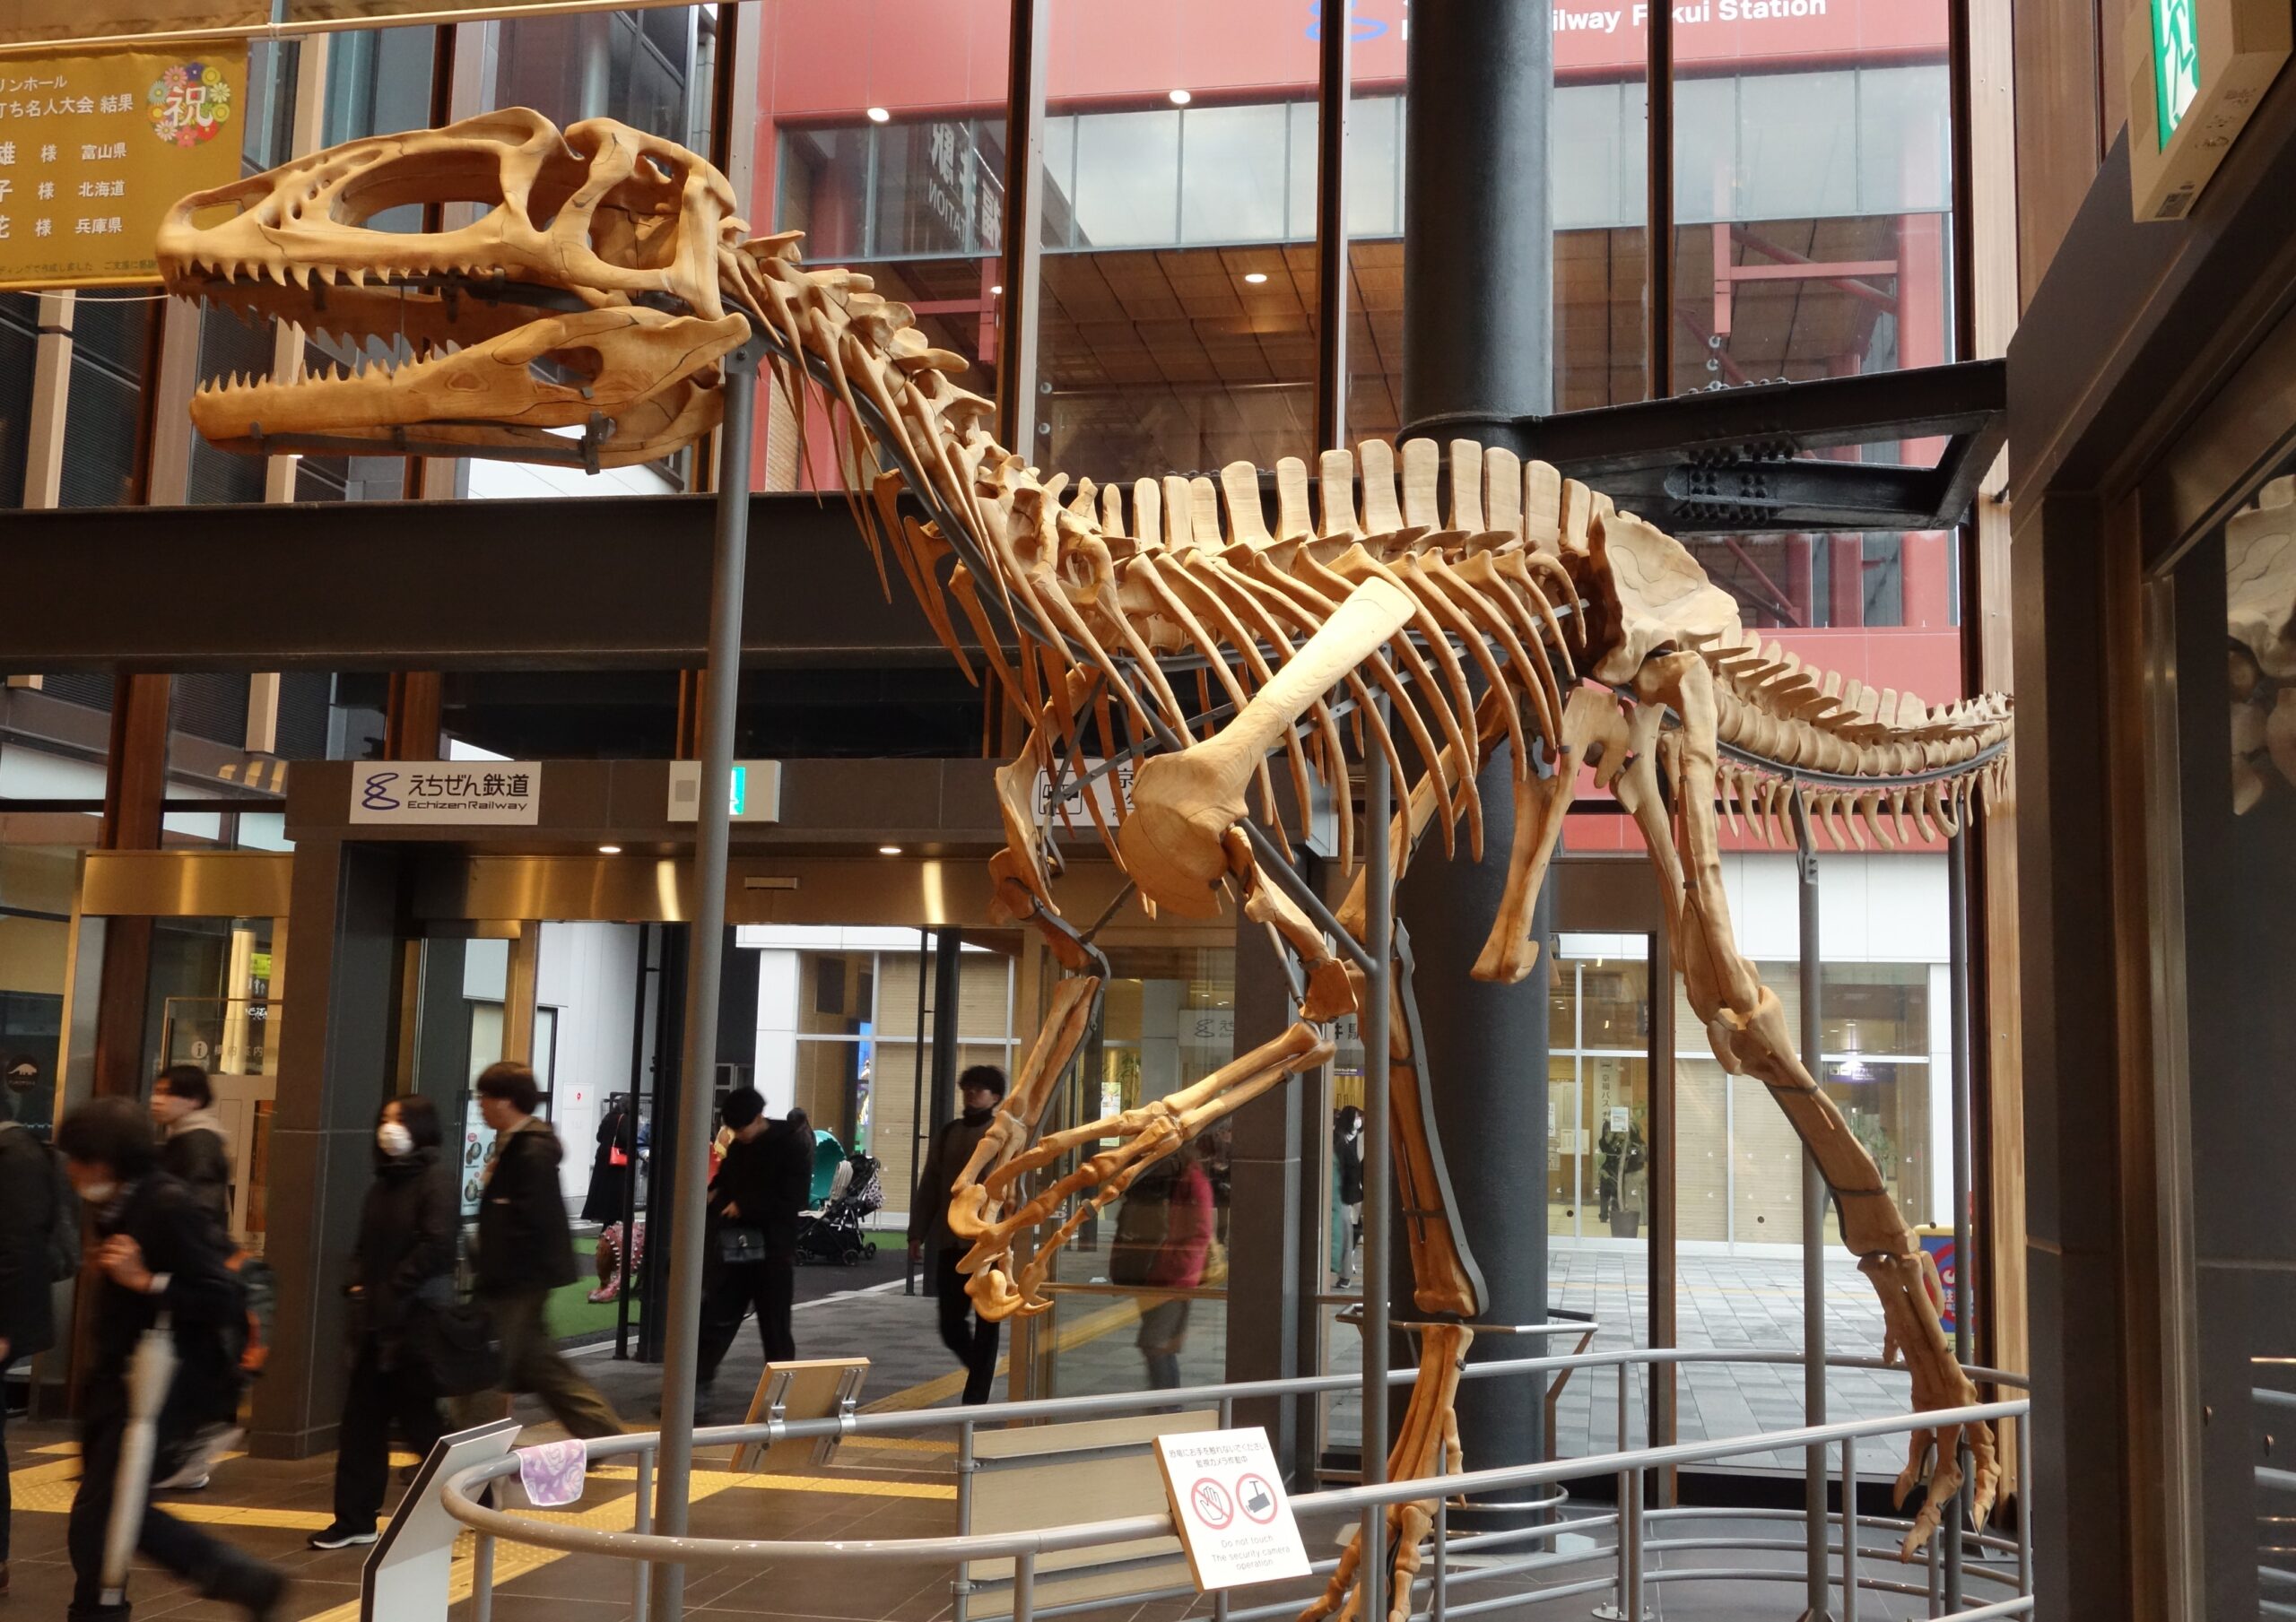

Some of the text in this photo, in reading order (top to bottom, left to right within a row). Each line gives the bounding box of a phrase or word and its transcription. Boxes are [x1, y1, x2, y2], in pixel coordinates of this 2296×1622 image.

[1552, 0, 1826, 33] ilway Fkui Station
[100, 93, 134, 114] 結果
[164, 86, 213, 127] 祝
[40, 144, 57, 163] 様
[81, 142, 127, 160] 富山県
[38, 181, 55, 200] 様
[78, 179, 126, 197] 北海道
[36, 218, 52, 237] 様
[75, 217, 123, 234] 兵庫県
[408, 773, 529, 796] えちぜん鉄道
[407, 801, 528, 811] Echizen Railway
[1221, 1534, 1274, 1548] Do not touch
[1212, 1545, 1291, 1562] The security camera
[1236, 1558, 1274, 1571] operation
